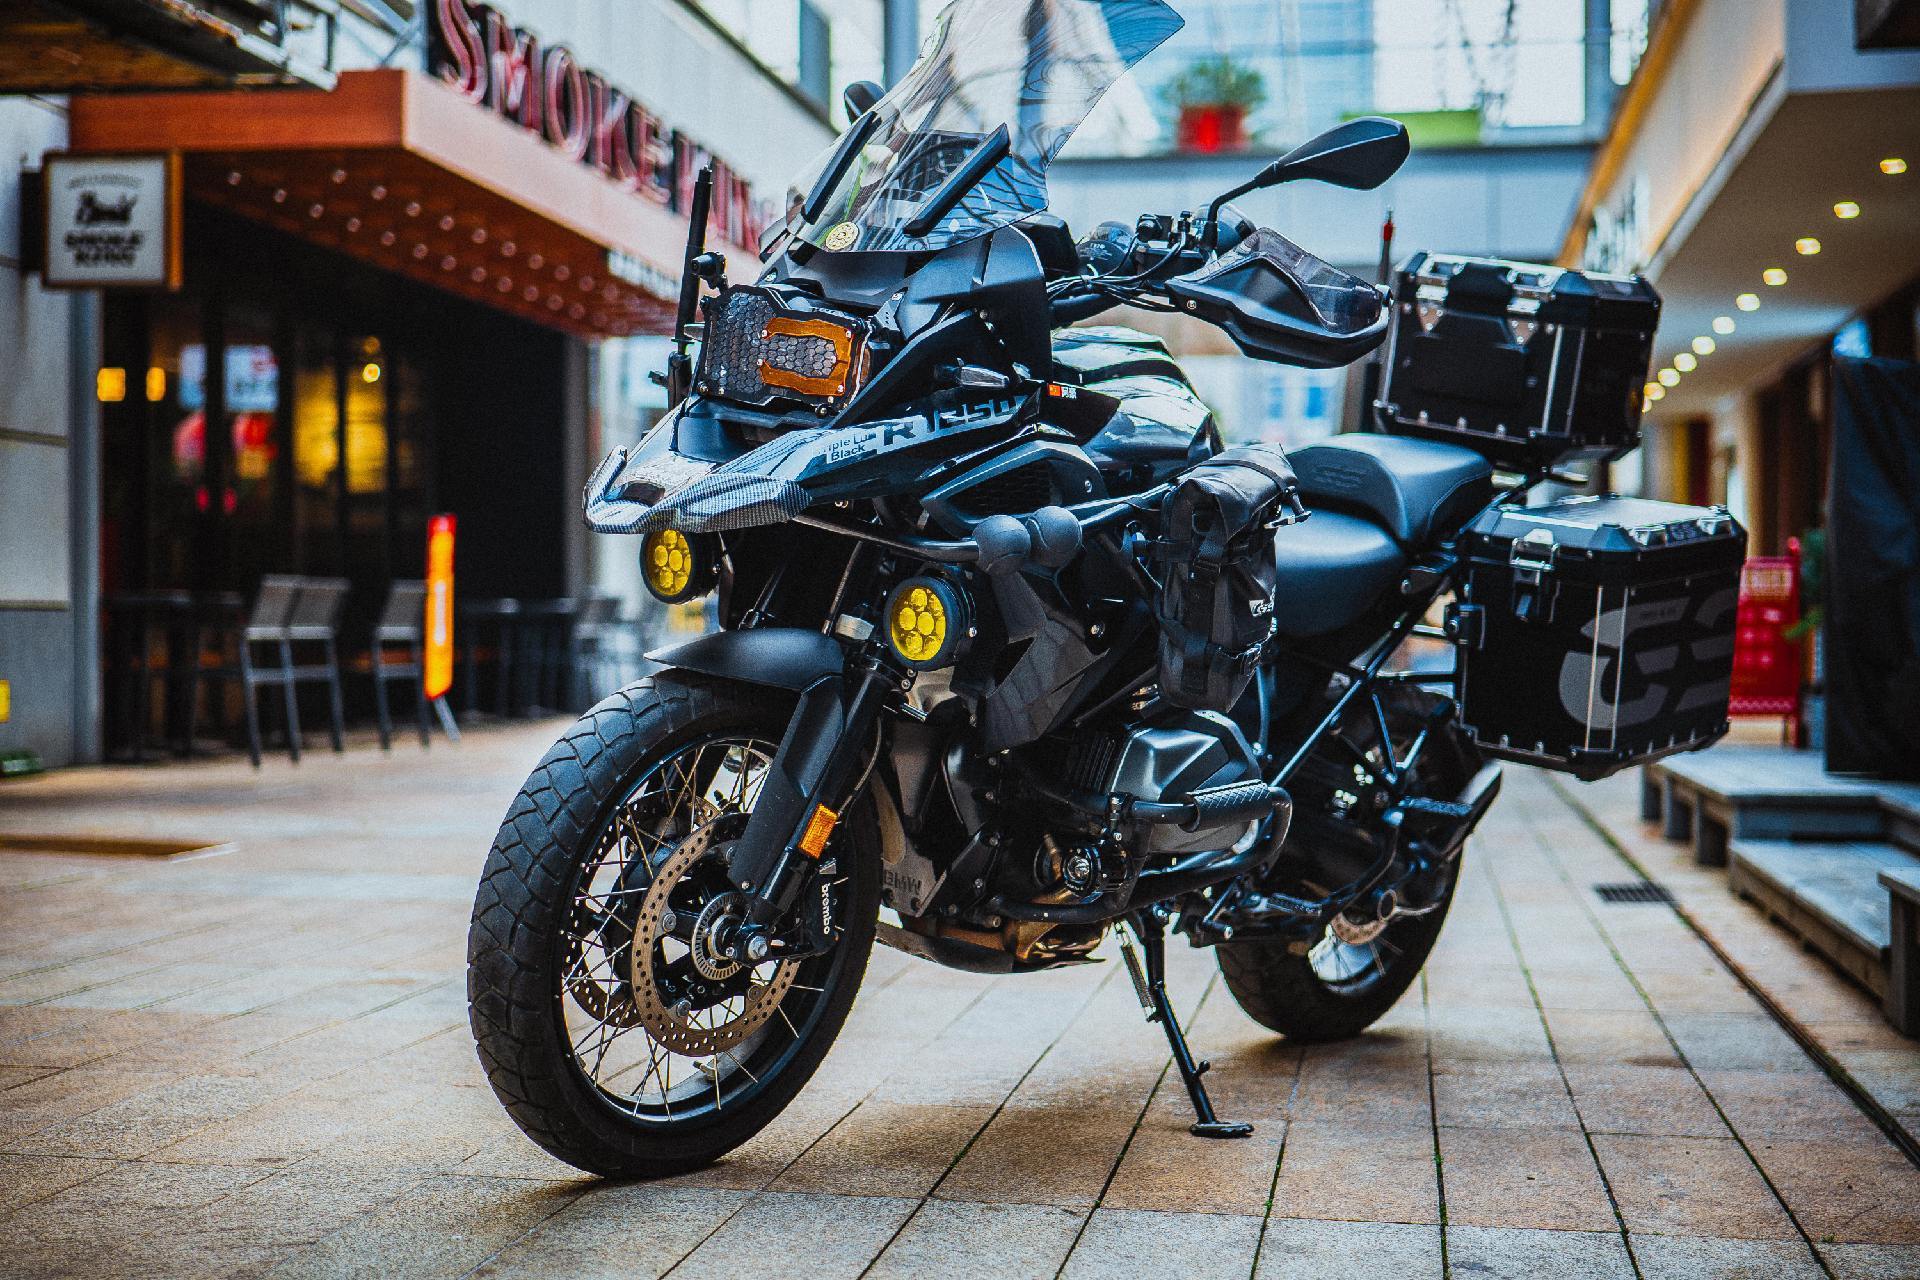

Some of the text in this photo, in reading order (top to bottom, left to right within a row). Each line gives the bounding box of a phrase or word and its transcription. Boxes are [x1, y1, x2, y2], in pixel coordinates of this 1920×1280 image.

[428, 0, 673, 209] SMOKE
[831, 444, 866, 461] Black
[884, 869, 923, 897] BMW
[821, 882, 832, 935] brembo
